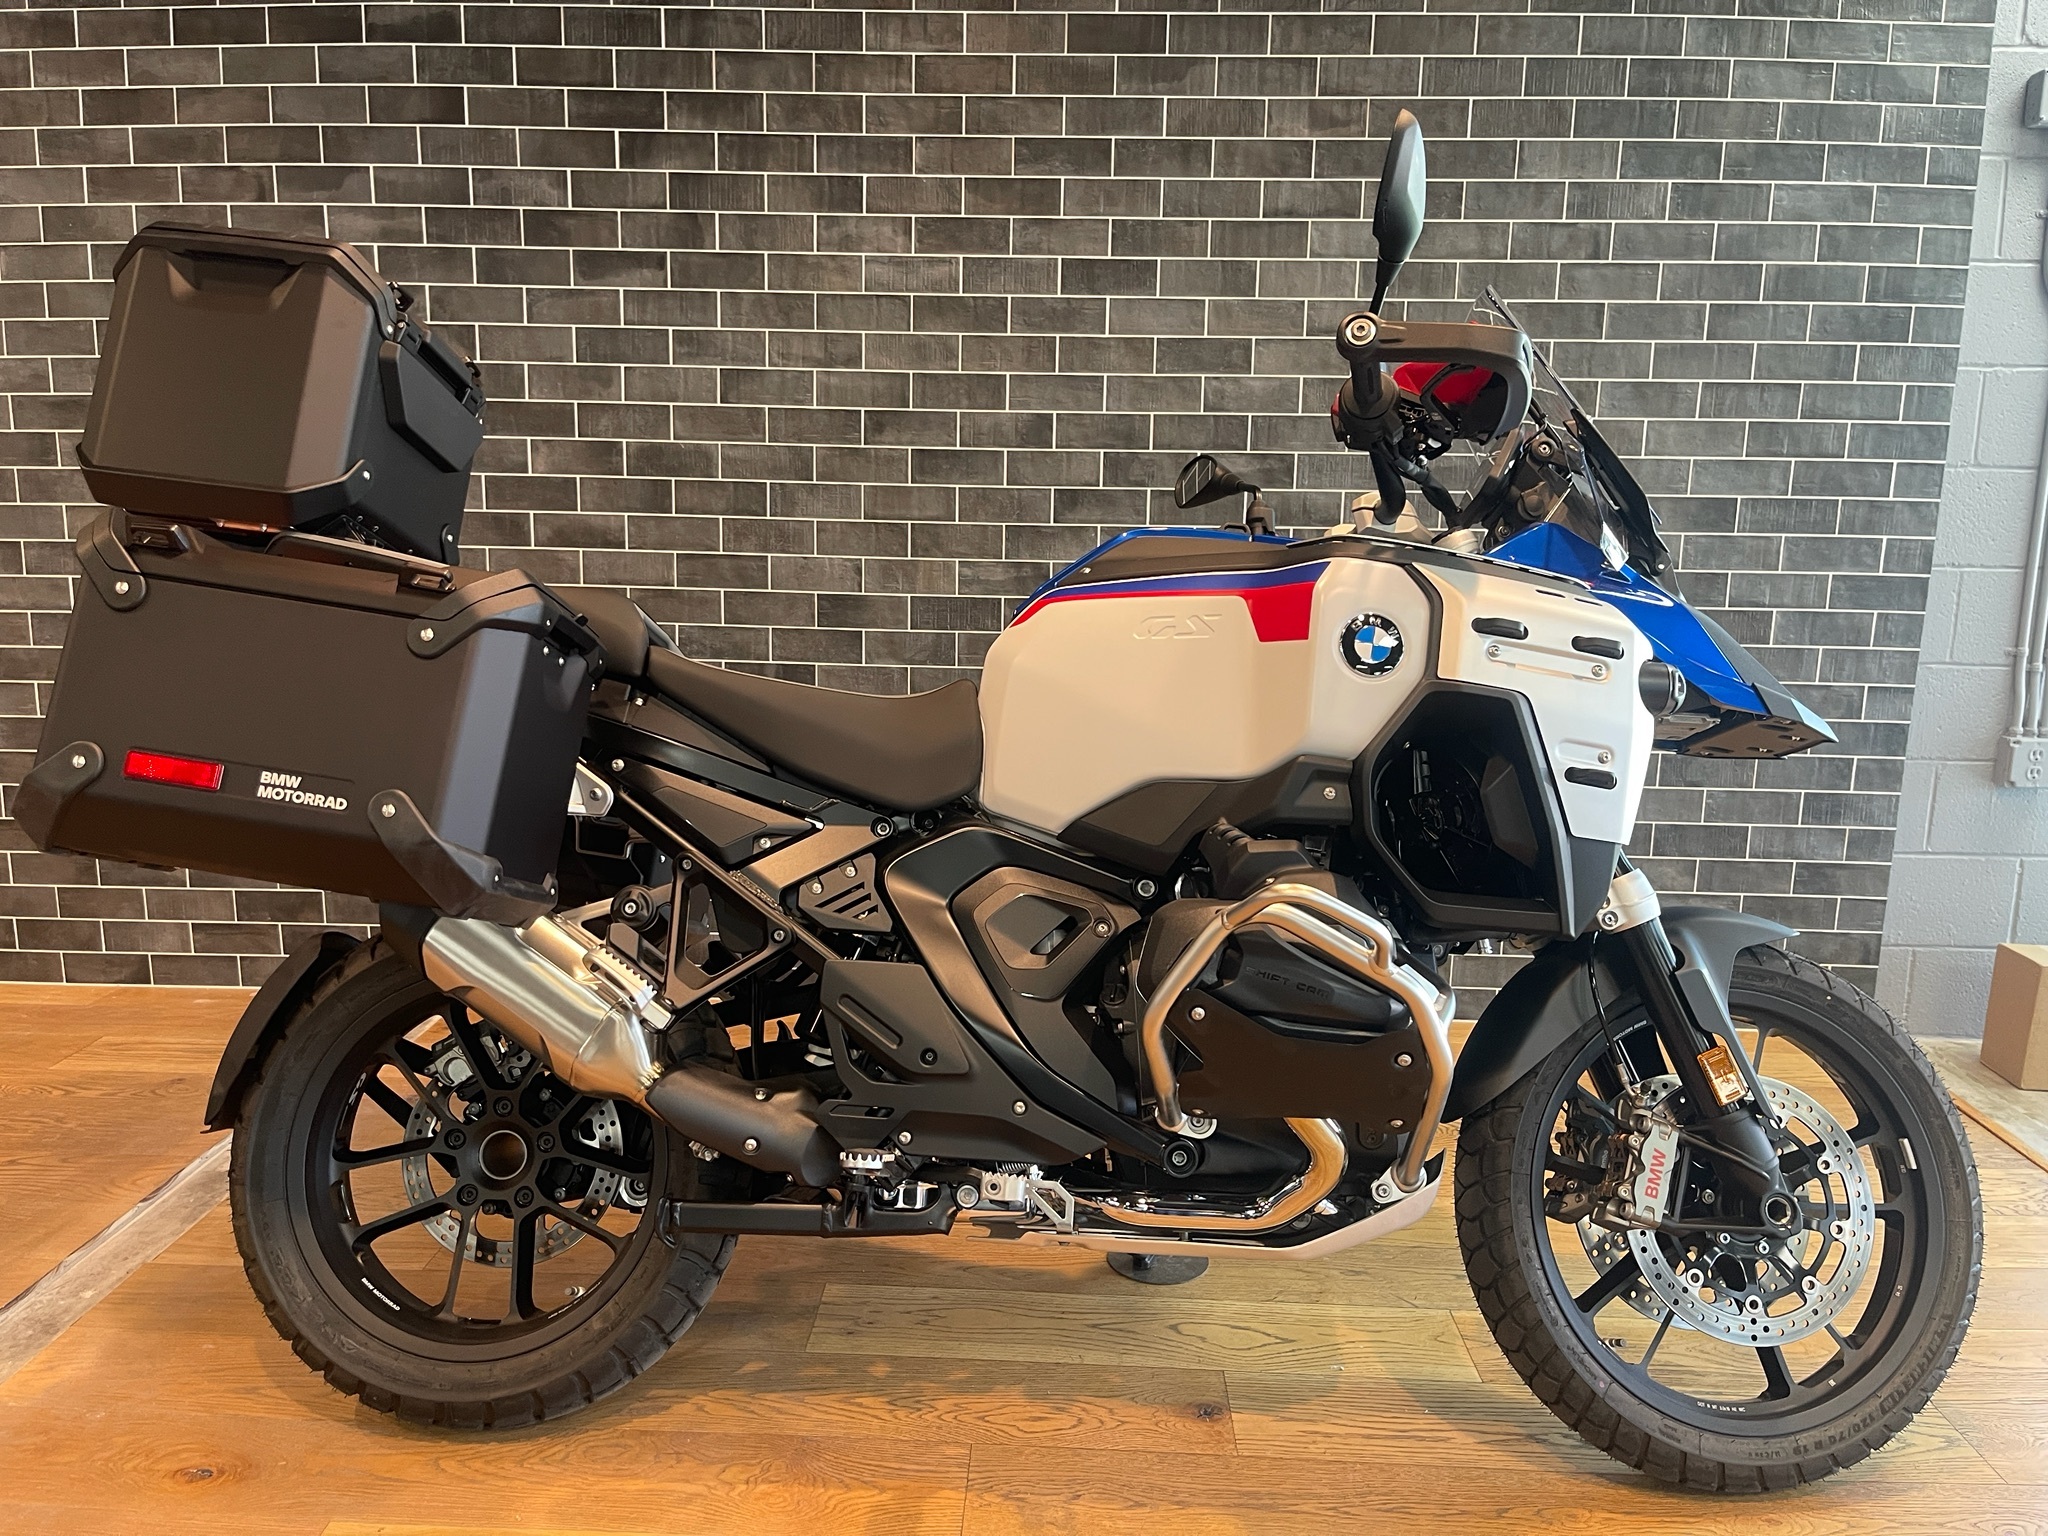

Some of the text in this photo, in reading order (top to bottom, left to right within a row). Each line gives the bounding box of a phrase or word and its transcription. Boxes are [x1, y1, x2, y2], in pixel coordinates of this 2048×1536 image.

[260, 770, 303, 789] BMW
[256, 784, 349, 811] MOTORRAD
[1245, 965, 1290, 986] SHIFT
[1644, 1147, 1668, 1200] BMW
[361, 1276, 401, 1311] BMW MOTORRAD
